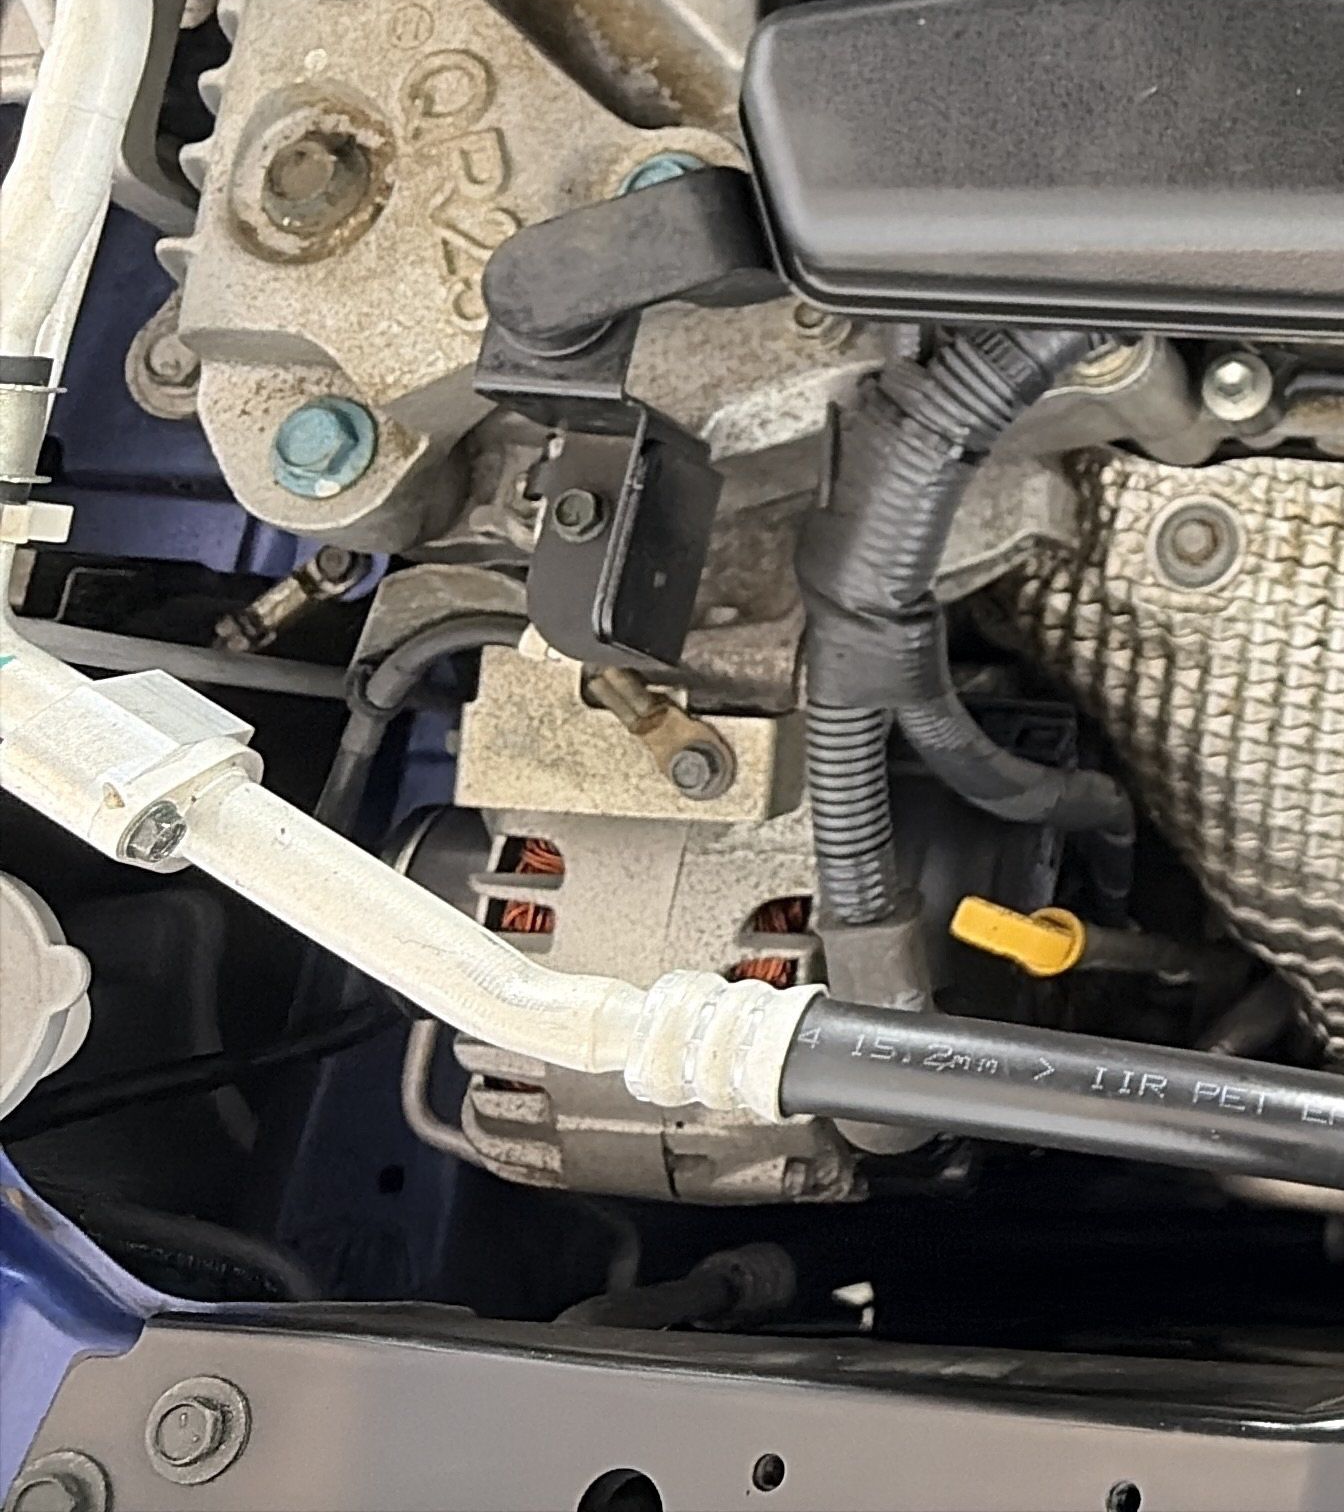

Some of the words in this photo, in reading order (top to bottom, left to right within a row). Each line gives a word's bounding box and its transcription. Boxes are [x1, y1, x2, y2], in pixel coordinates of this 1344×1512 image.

[851, 1039, 999, 1075] 15.2mm
[1091, 1066, 1168, 1100] IIR
[1193, 1081, 1271, 1116] PET
